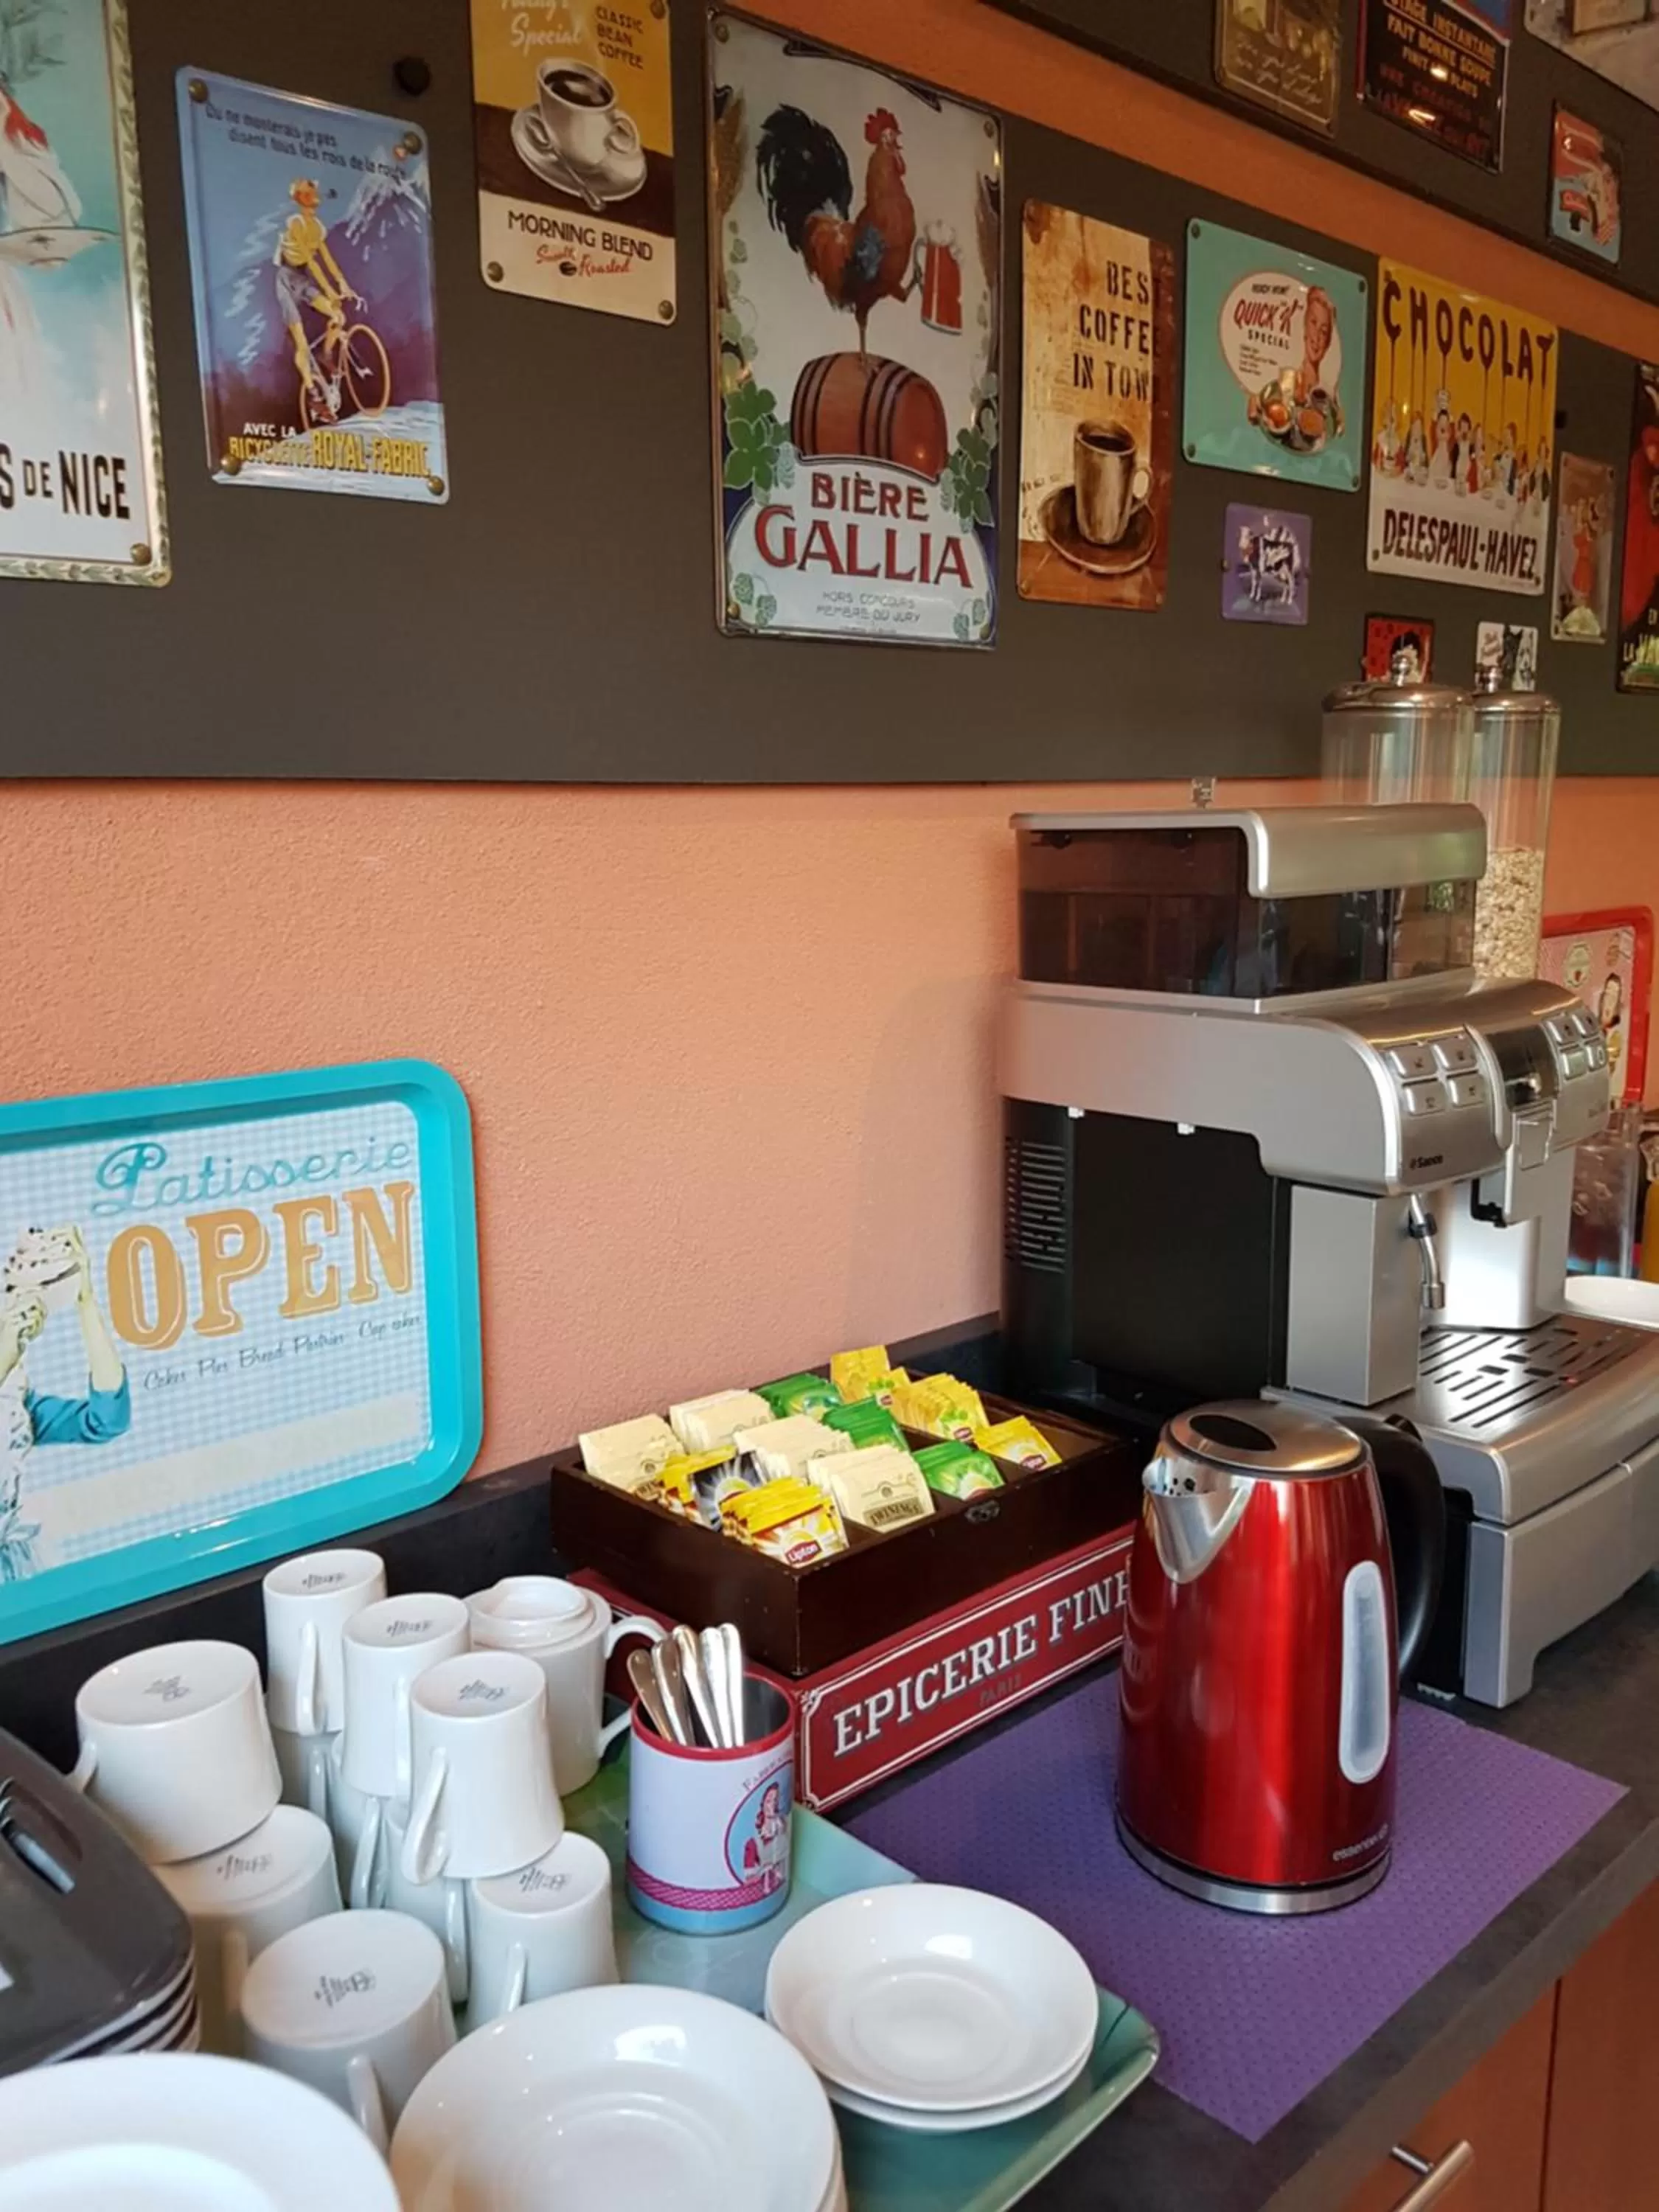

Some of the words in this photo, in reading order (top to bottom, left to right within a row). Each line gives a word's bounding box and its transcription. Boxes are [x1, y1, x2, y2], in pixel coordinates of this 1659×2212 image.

[510, 12, 582, 58] Special
[597, 23, 633, 47] BEAN
[598, 41, 644, 70] COFFEE
[507, 209, 596, 248] MORNING
[602, 232, 653, 261] BLEND
[1234, 299, 1279, 330] QUICK
[1248, 330, 1290, 350] SPECIAL
[1382, 280, 1555, 388] CHOCOLAT
[1073, 352, 1093, 389] IN
[243, 422, 276, 437] AVEC
[281, 425, 296, 438] LA
[23, 459, 53, 498] DE
[58, 450, 130, 519] NICE
[811, 471, 930, 522] BIÈRE
[754, 504, 973, 588] GALLIA
[91, 1137, 413, 1217] Patisserie
[107, 1180, 414, 1351] OPEN
[833, 1614, 1037, 1758] EPICERIE
